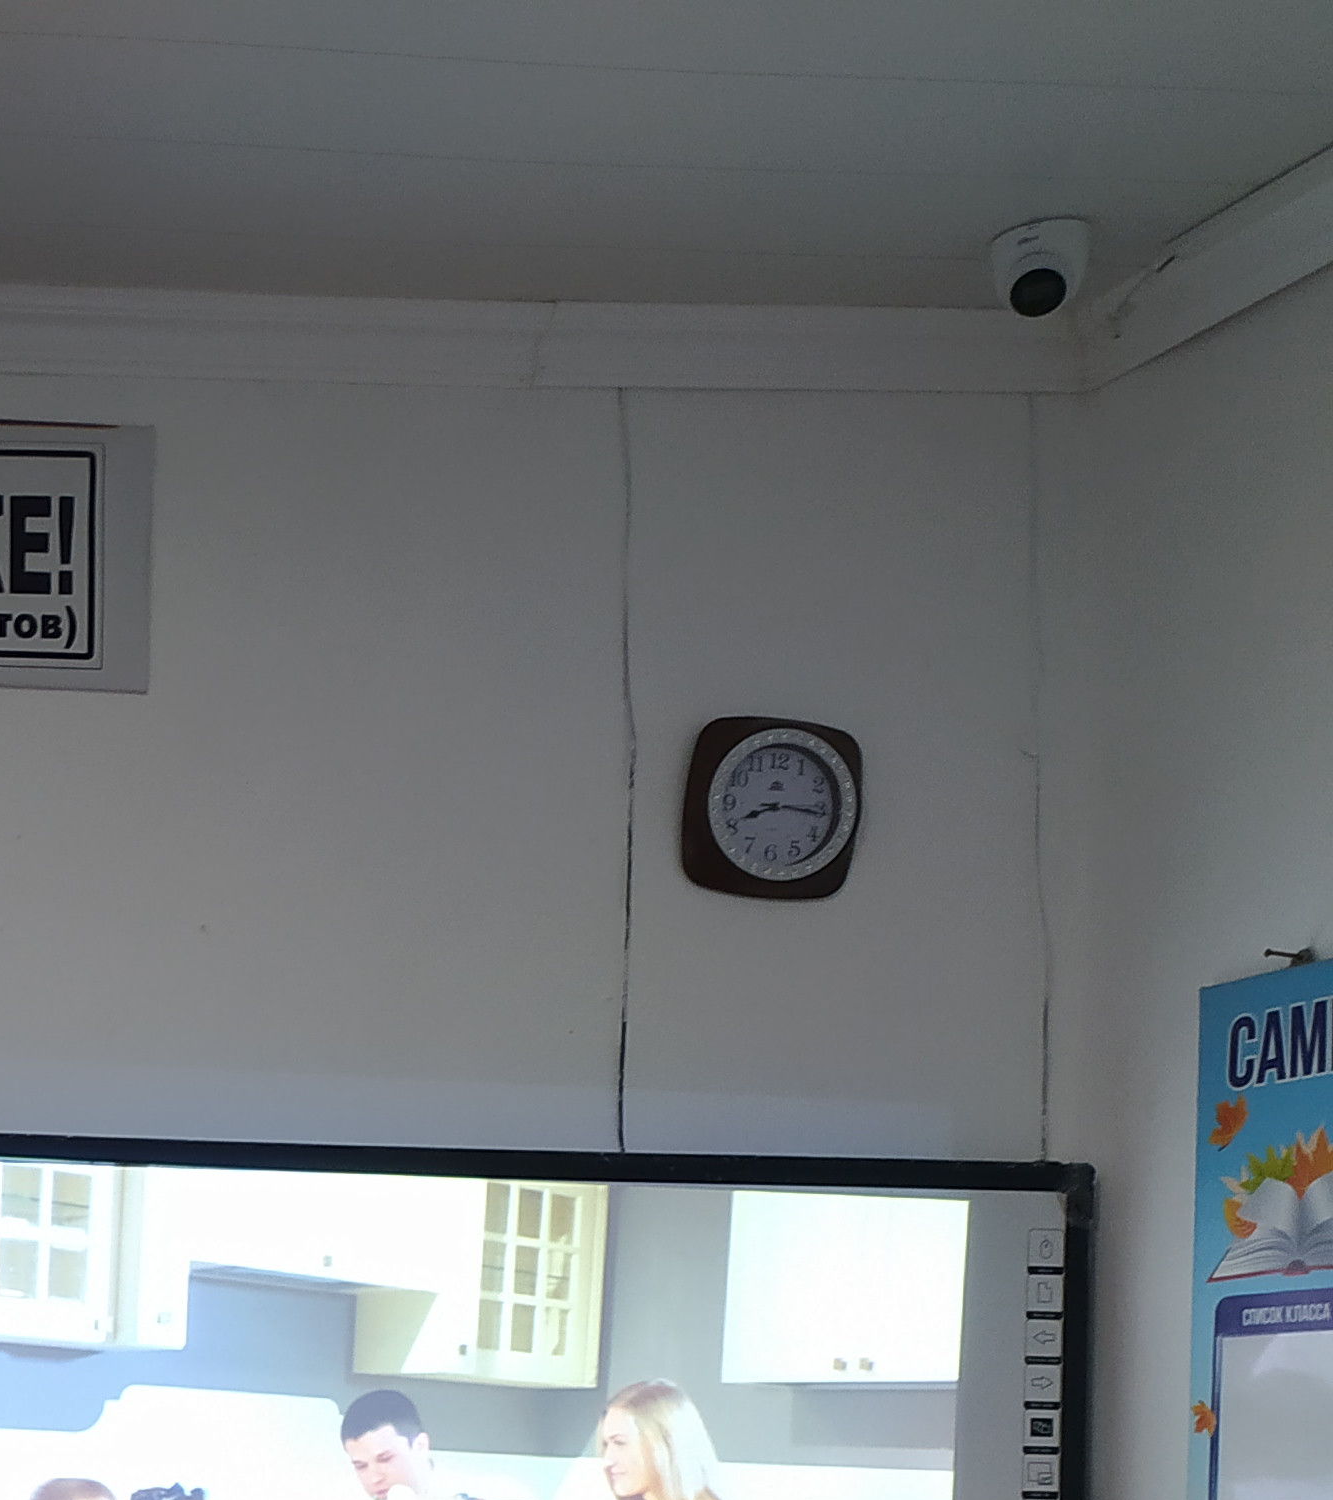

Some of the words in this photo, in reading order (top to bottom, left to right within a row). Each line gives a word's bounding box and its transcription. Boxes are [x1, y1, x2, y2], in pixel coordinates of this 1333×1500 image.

[748, 755, 763, 772] 11
[771, 753, 790, 771] 12
[798, 759, 805, 776] 1
[812, 776, 825, 794] 2
[722, 793, 736, 811] 9
[806, 825, 820, 842] 4
[744, 836, 757, 854] 7
[764, 844, 778, 861] 6
[789, 840, 801, 857] 5
[1228, 996, 1333, 1091] САМ
